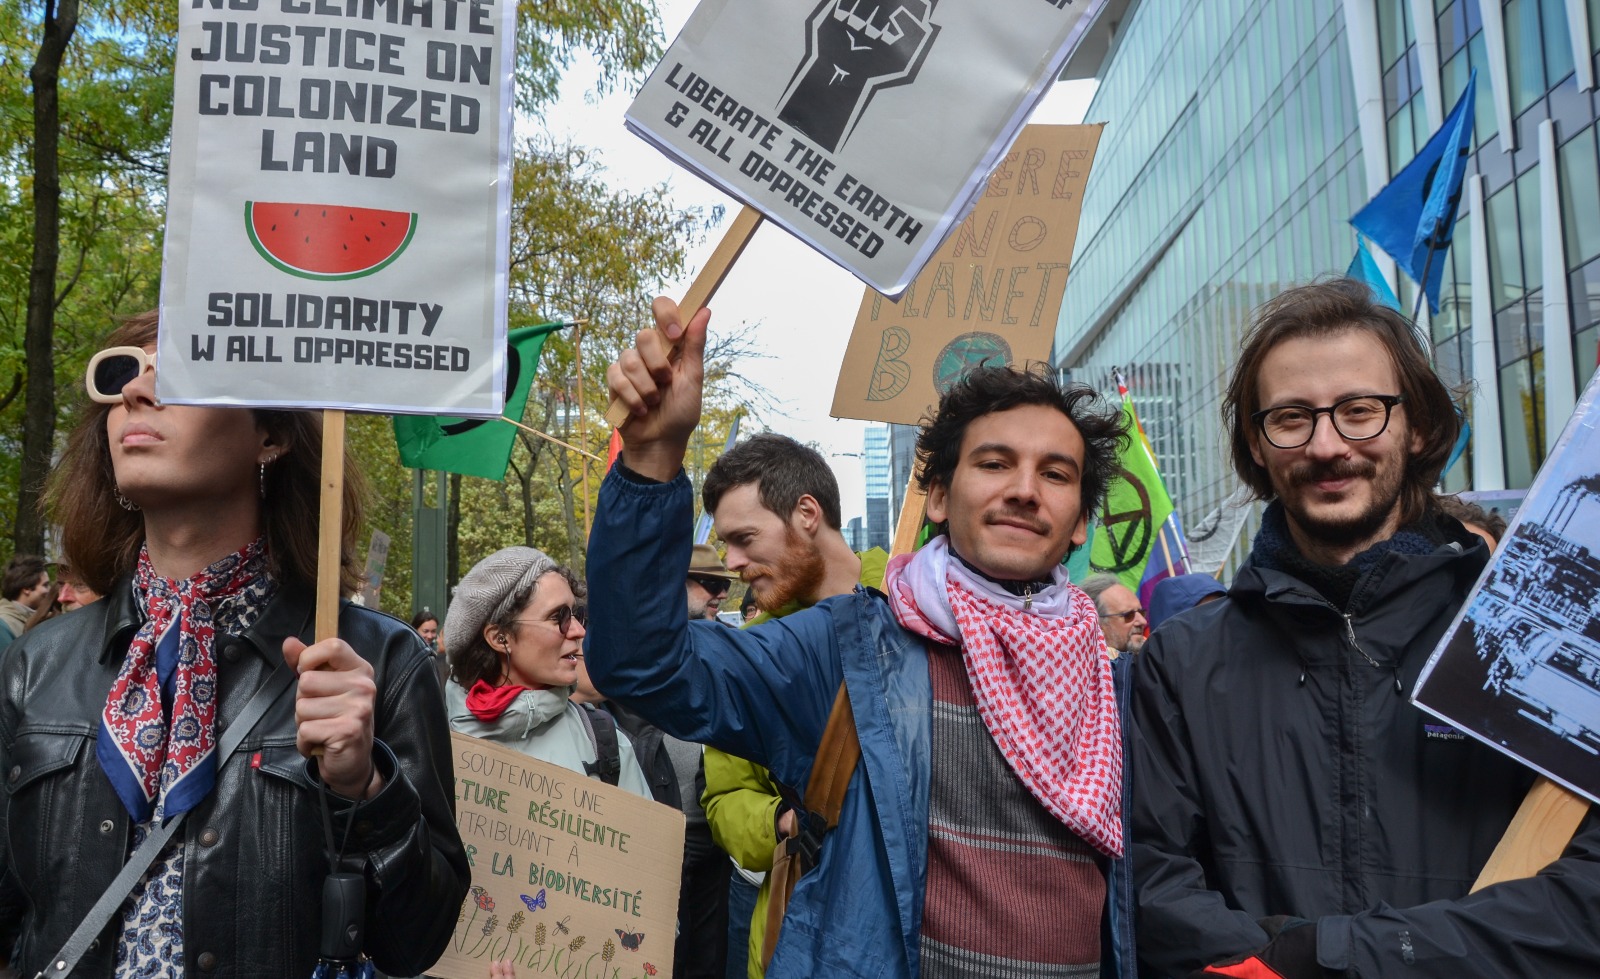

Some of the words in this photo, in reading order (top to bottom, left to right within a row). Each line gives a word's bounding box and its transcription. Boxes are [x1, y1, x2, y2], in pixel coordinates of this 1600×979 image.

[191, 21, 406, 76] JUSTICE
[426, 40, 493, 86] ON
[199, 74, 481, 135] COLONIZED
[260, 129, 398, 179] LAND
[664, 63, 789, 152] LIBERATE
[780, 137, 836, 187] THE
[833, 174, 924, 246] EARTH
[986, 148, 1089, 200] ERE
[664, 101, 688, 129] &
[688, 118, 732, 164] ALL
[738, 150, 884, 260] OPPRESSED
[953, 210, 1048, 258] NO
[207, 292, 444, 337] SOLIDARITY
[871, 262, 1069, 327] LANET
[191, 335, 216, 362] W
[226, 335, 283, 363] ALL
[294, 336, 470, 372] OPPRESSED
[864, 326, 912, 402] B
[1427, 731, 1466, 740] patagonia
[459, 750, 566, 800] SOUTENONS
[573, 787, 606, 816] UNE
[491, 851, 514, 878] LA
[567, 841, 579, 868] À
